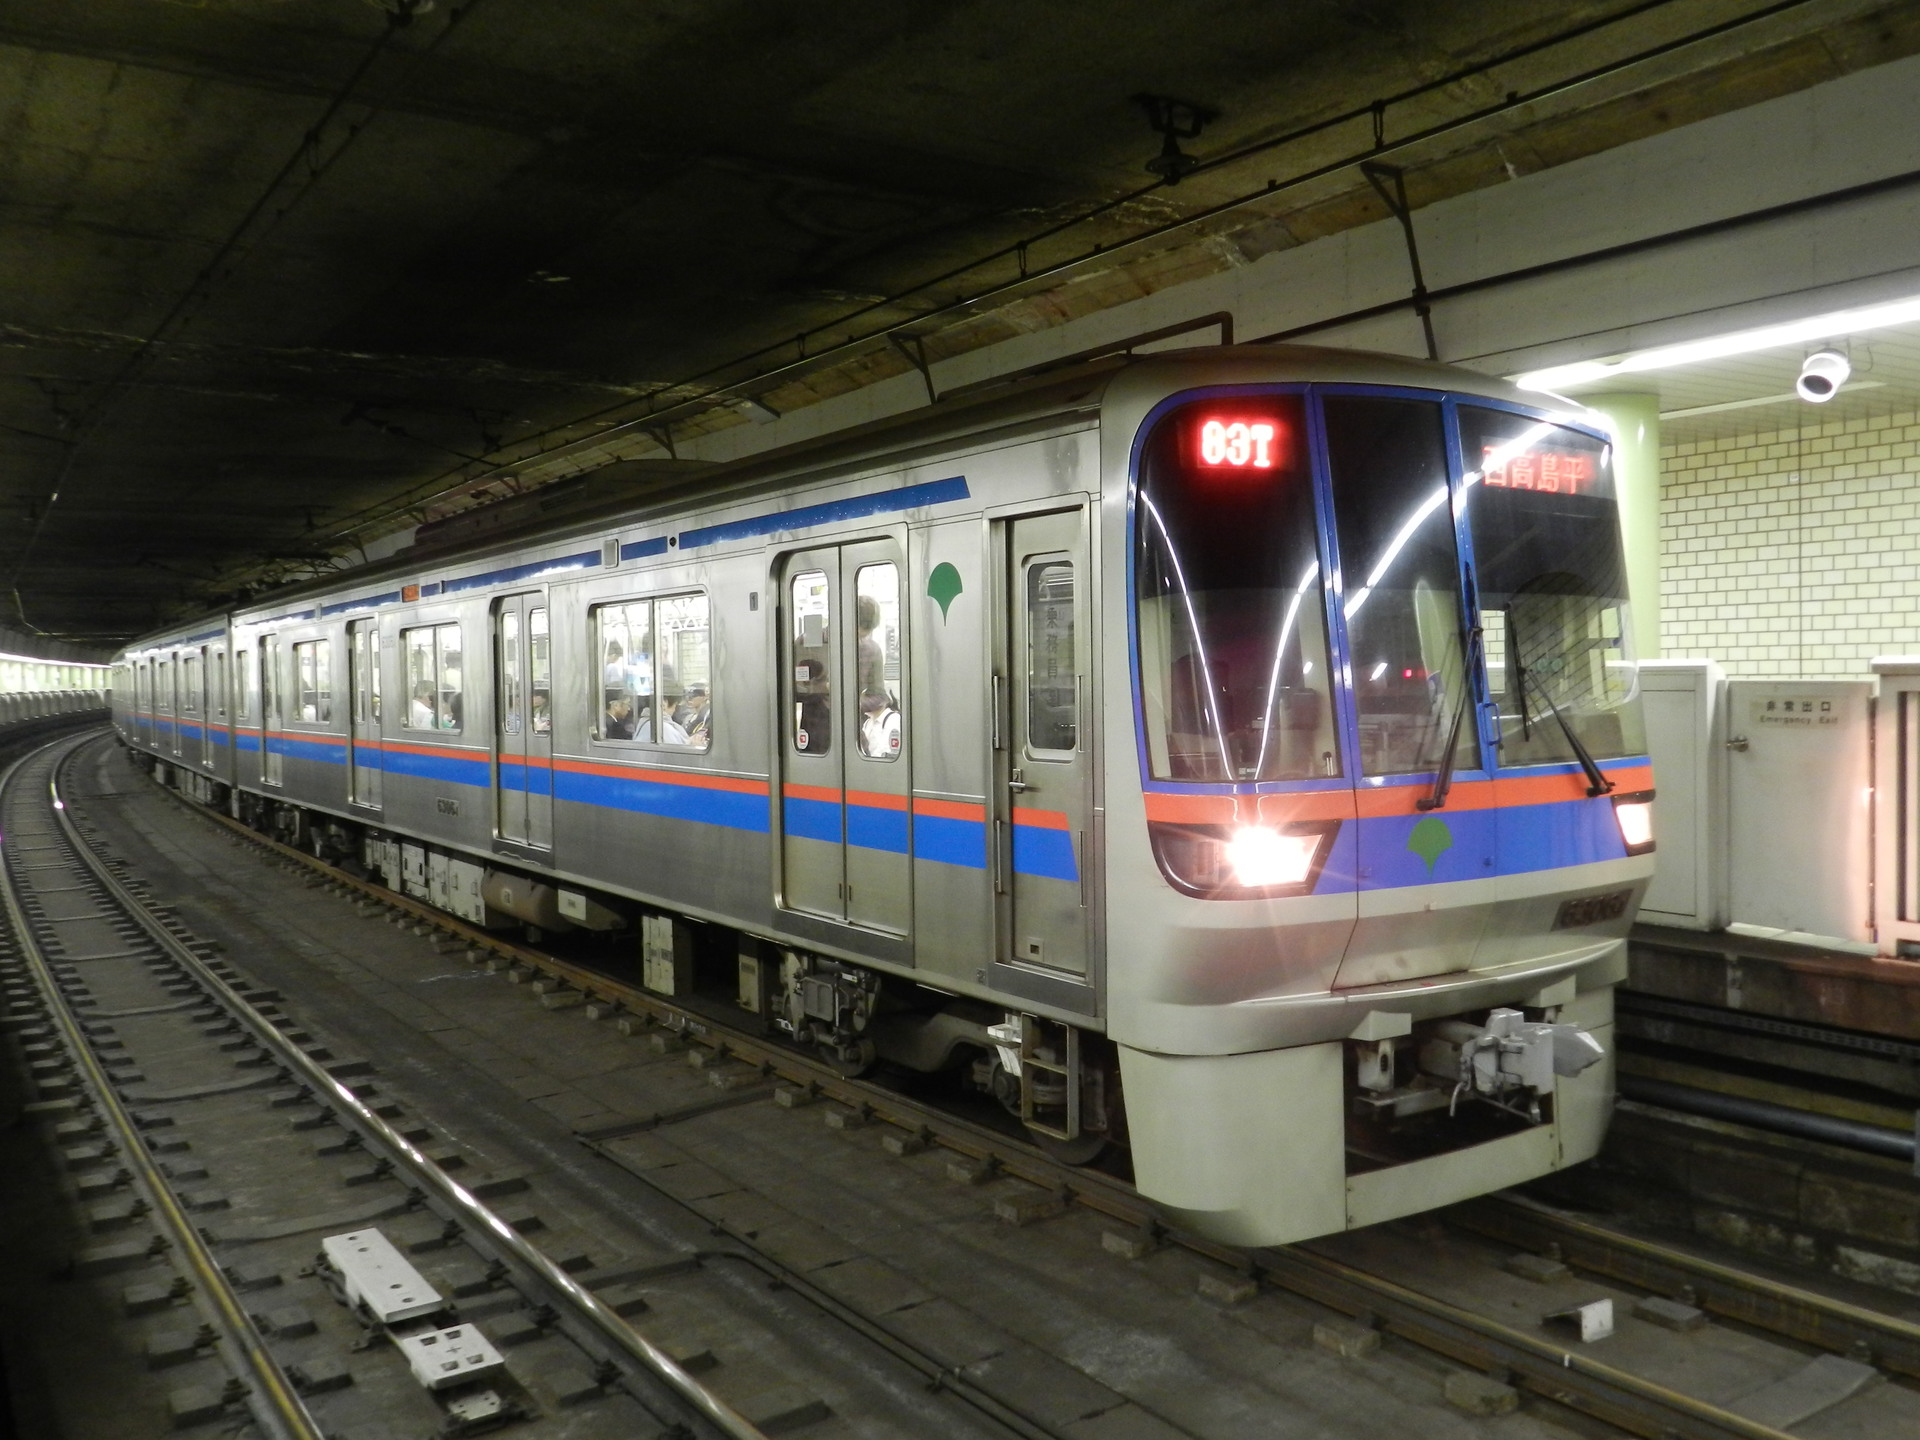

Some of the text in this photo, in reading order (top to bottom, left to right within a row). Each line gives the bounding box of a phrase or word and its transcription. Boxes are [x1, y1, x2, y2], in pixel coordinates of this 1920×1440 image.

[1766, 700, 1831, 712] 非常出口
[1759, 715, 1839, 725] Emergency Exit
